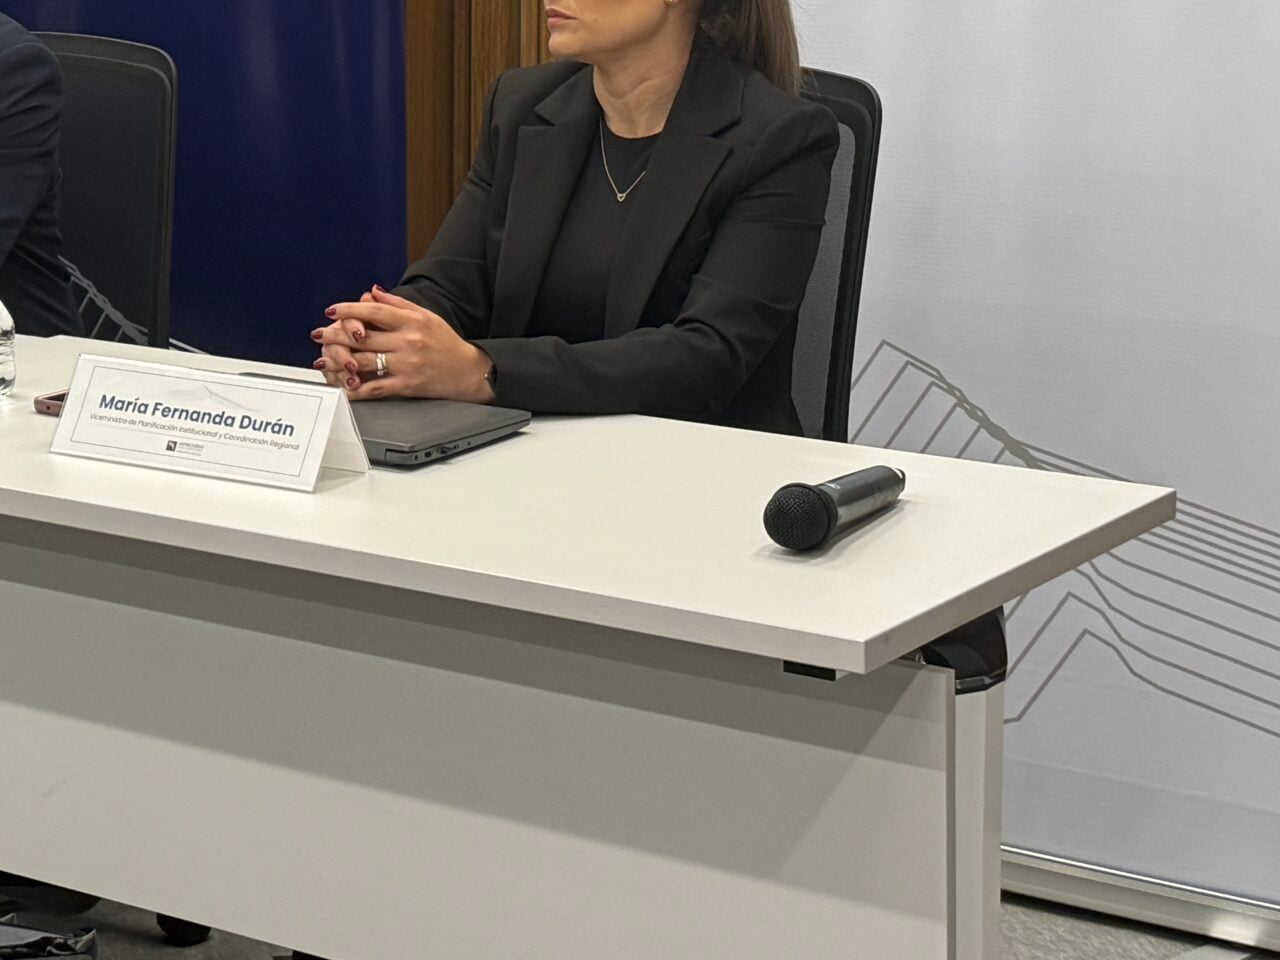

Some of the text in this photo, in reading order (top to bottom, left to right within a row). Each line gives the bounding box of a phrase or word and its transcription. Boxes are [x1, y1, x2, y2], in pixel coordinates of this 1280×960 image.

[89, 412, 128, 425] Viceministra
[128, 418, 137, 426] de
[137, 419, 179, 432] Planificación
[178, 425, 219, 438] Institucional
[223, 432, 269, 446] Coordinación
[269, 439, 300, 450] Regional
[98, 393, 295, 437] María Fernanda Durán
